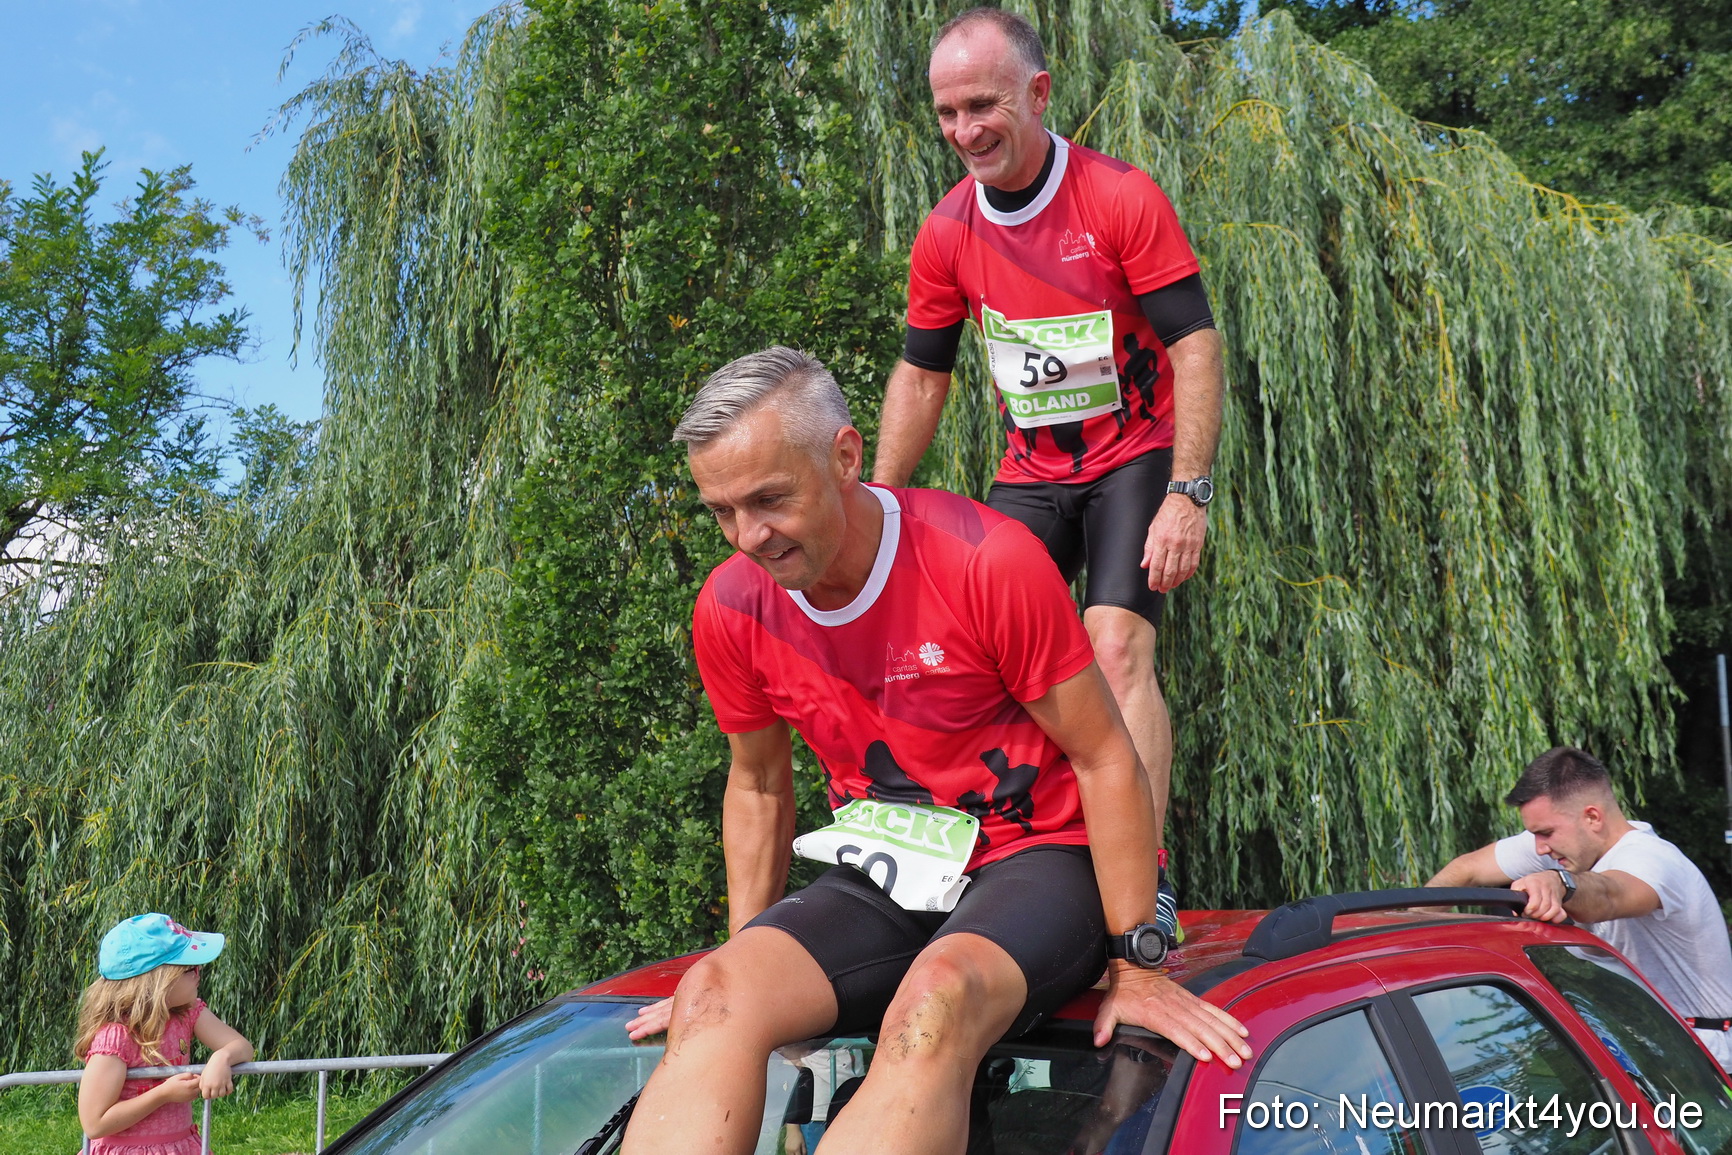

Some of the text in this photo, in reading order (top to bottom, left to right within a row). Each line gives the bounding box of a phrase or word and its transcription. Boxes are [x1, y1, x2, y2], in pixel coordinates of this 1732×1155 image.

[1019, 351, 1068, 388] 59
[1009, 392, 1091, 414] ROLAND
[892, 664, 918, 673] caritas
[924, 665, 951, 676] caritas
[941, 875, 954, 883] E6
